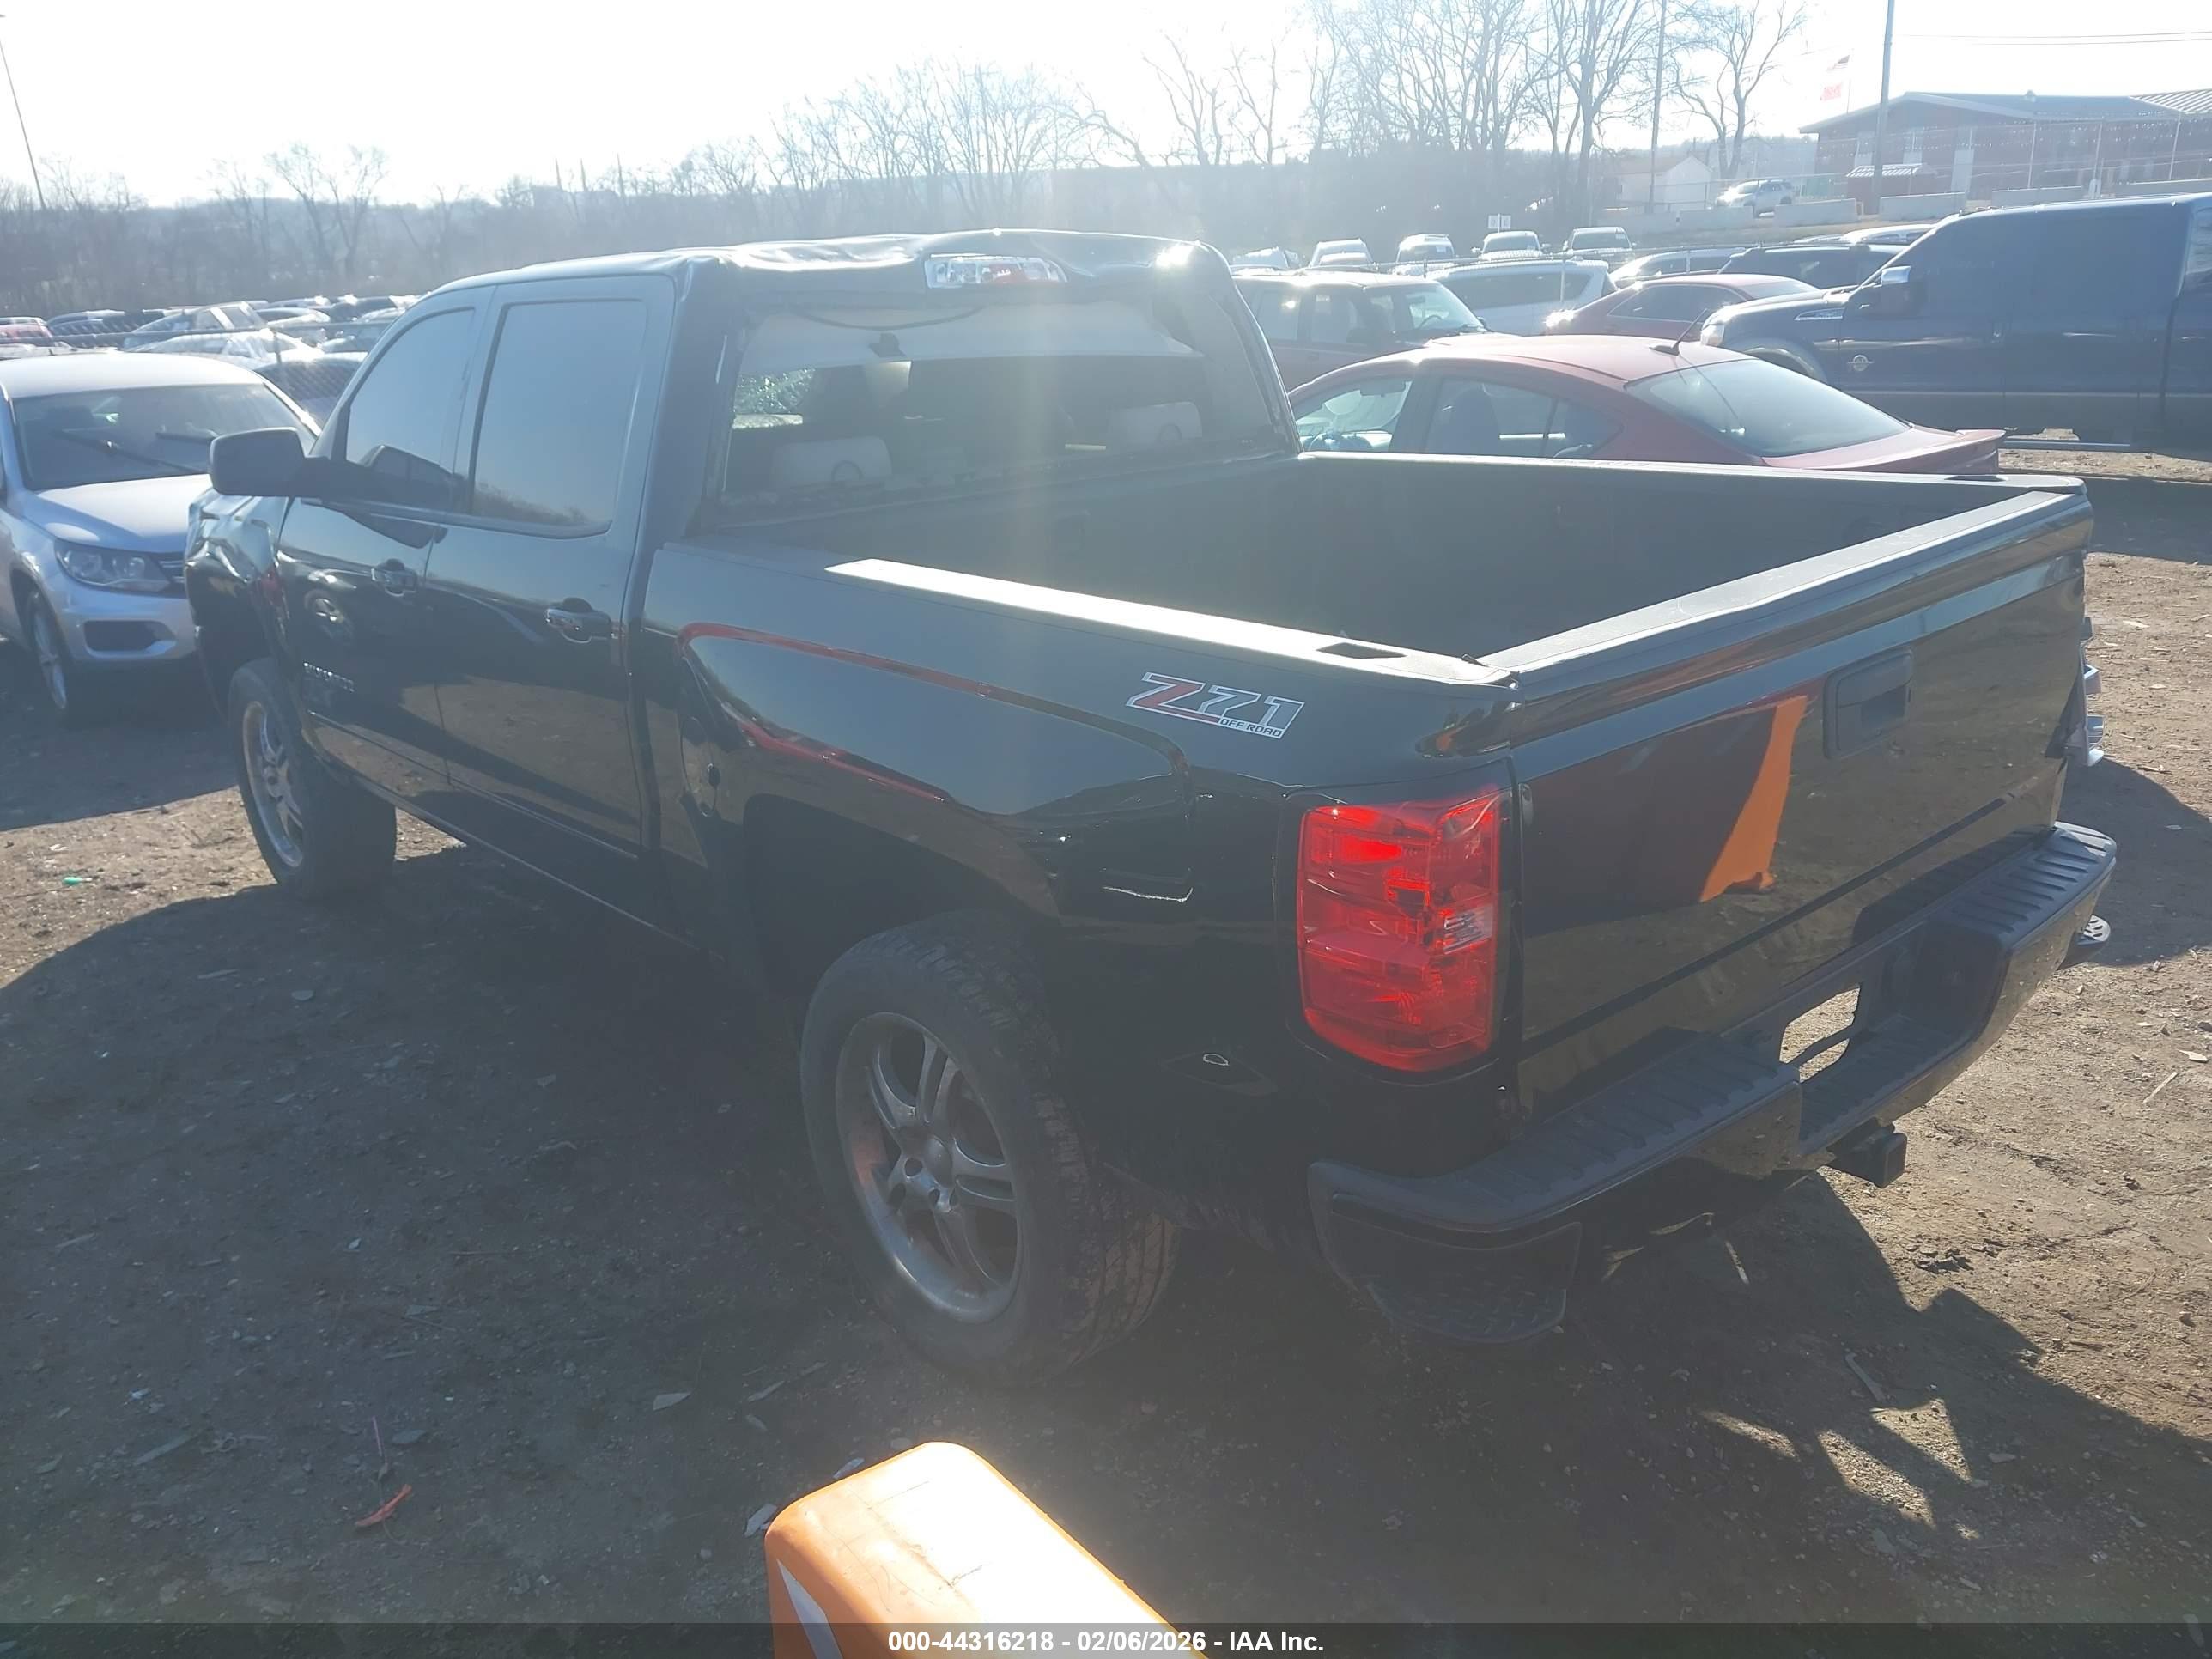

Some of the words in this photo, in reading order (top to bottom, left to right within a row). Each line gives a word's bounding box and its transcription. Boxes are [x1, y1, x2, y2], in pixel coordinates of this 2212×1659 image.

[1126, 672, 1305, 730] Z71
[1219, 717, 1246, 730] OFF
[1246, 723, 1283, 738] ROAD
